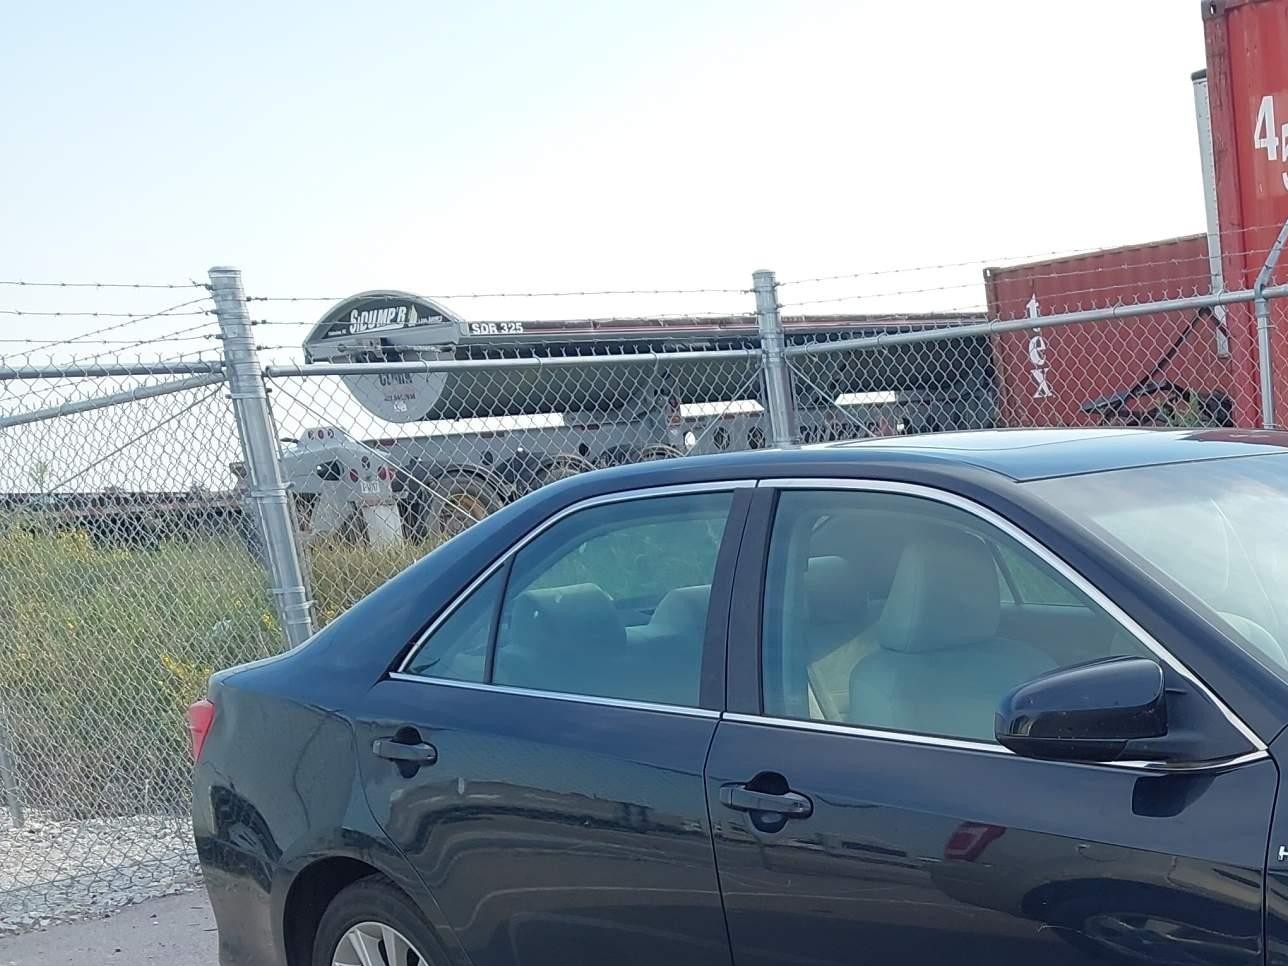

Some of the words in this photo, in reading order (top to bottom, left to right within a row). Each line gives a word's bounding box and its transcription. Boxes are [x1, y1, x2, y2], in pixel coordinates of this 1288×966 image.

[471, 322, 498, 335] SDR
[500, 322, 524, 334] 325
[1025, 293, 1053, 399] tex
